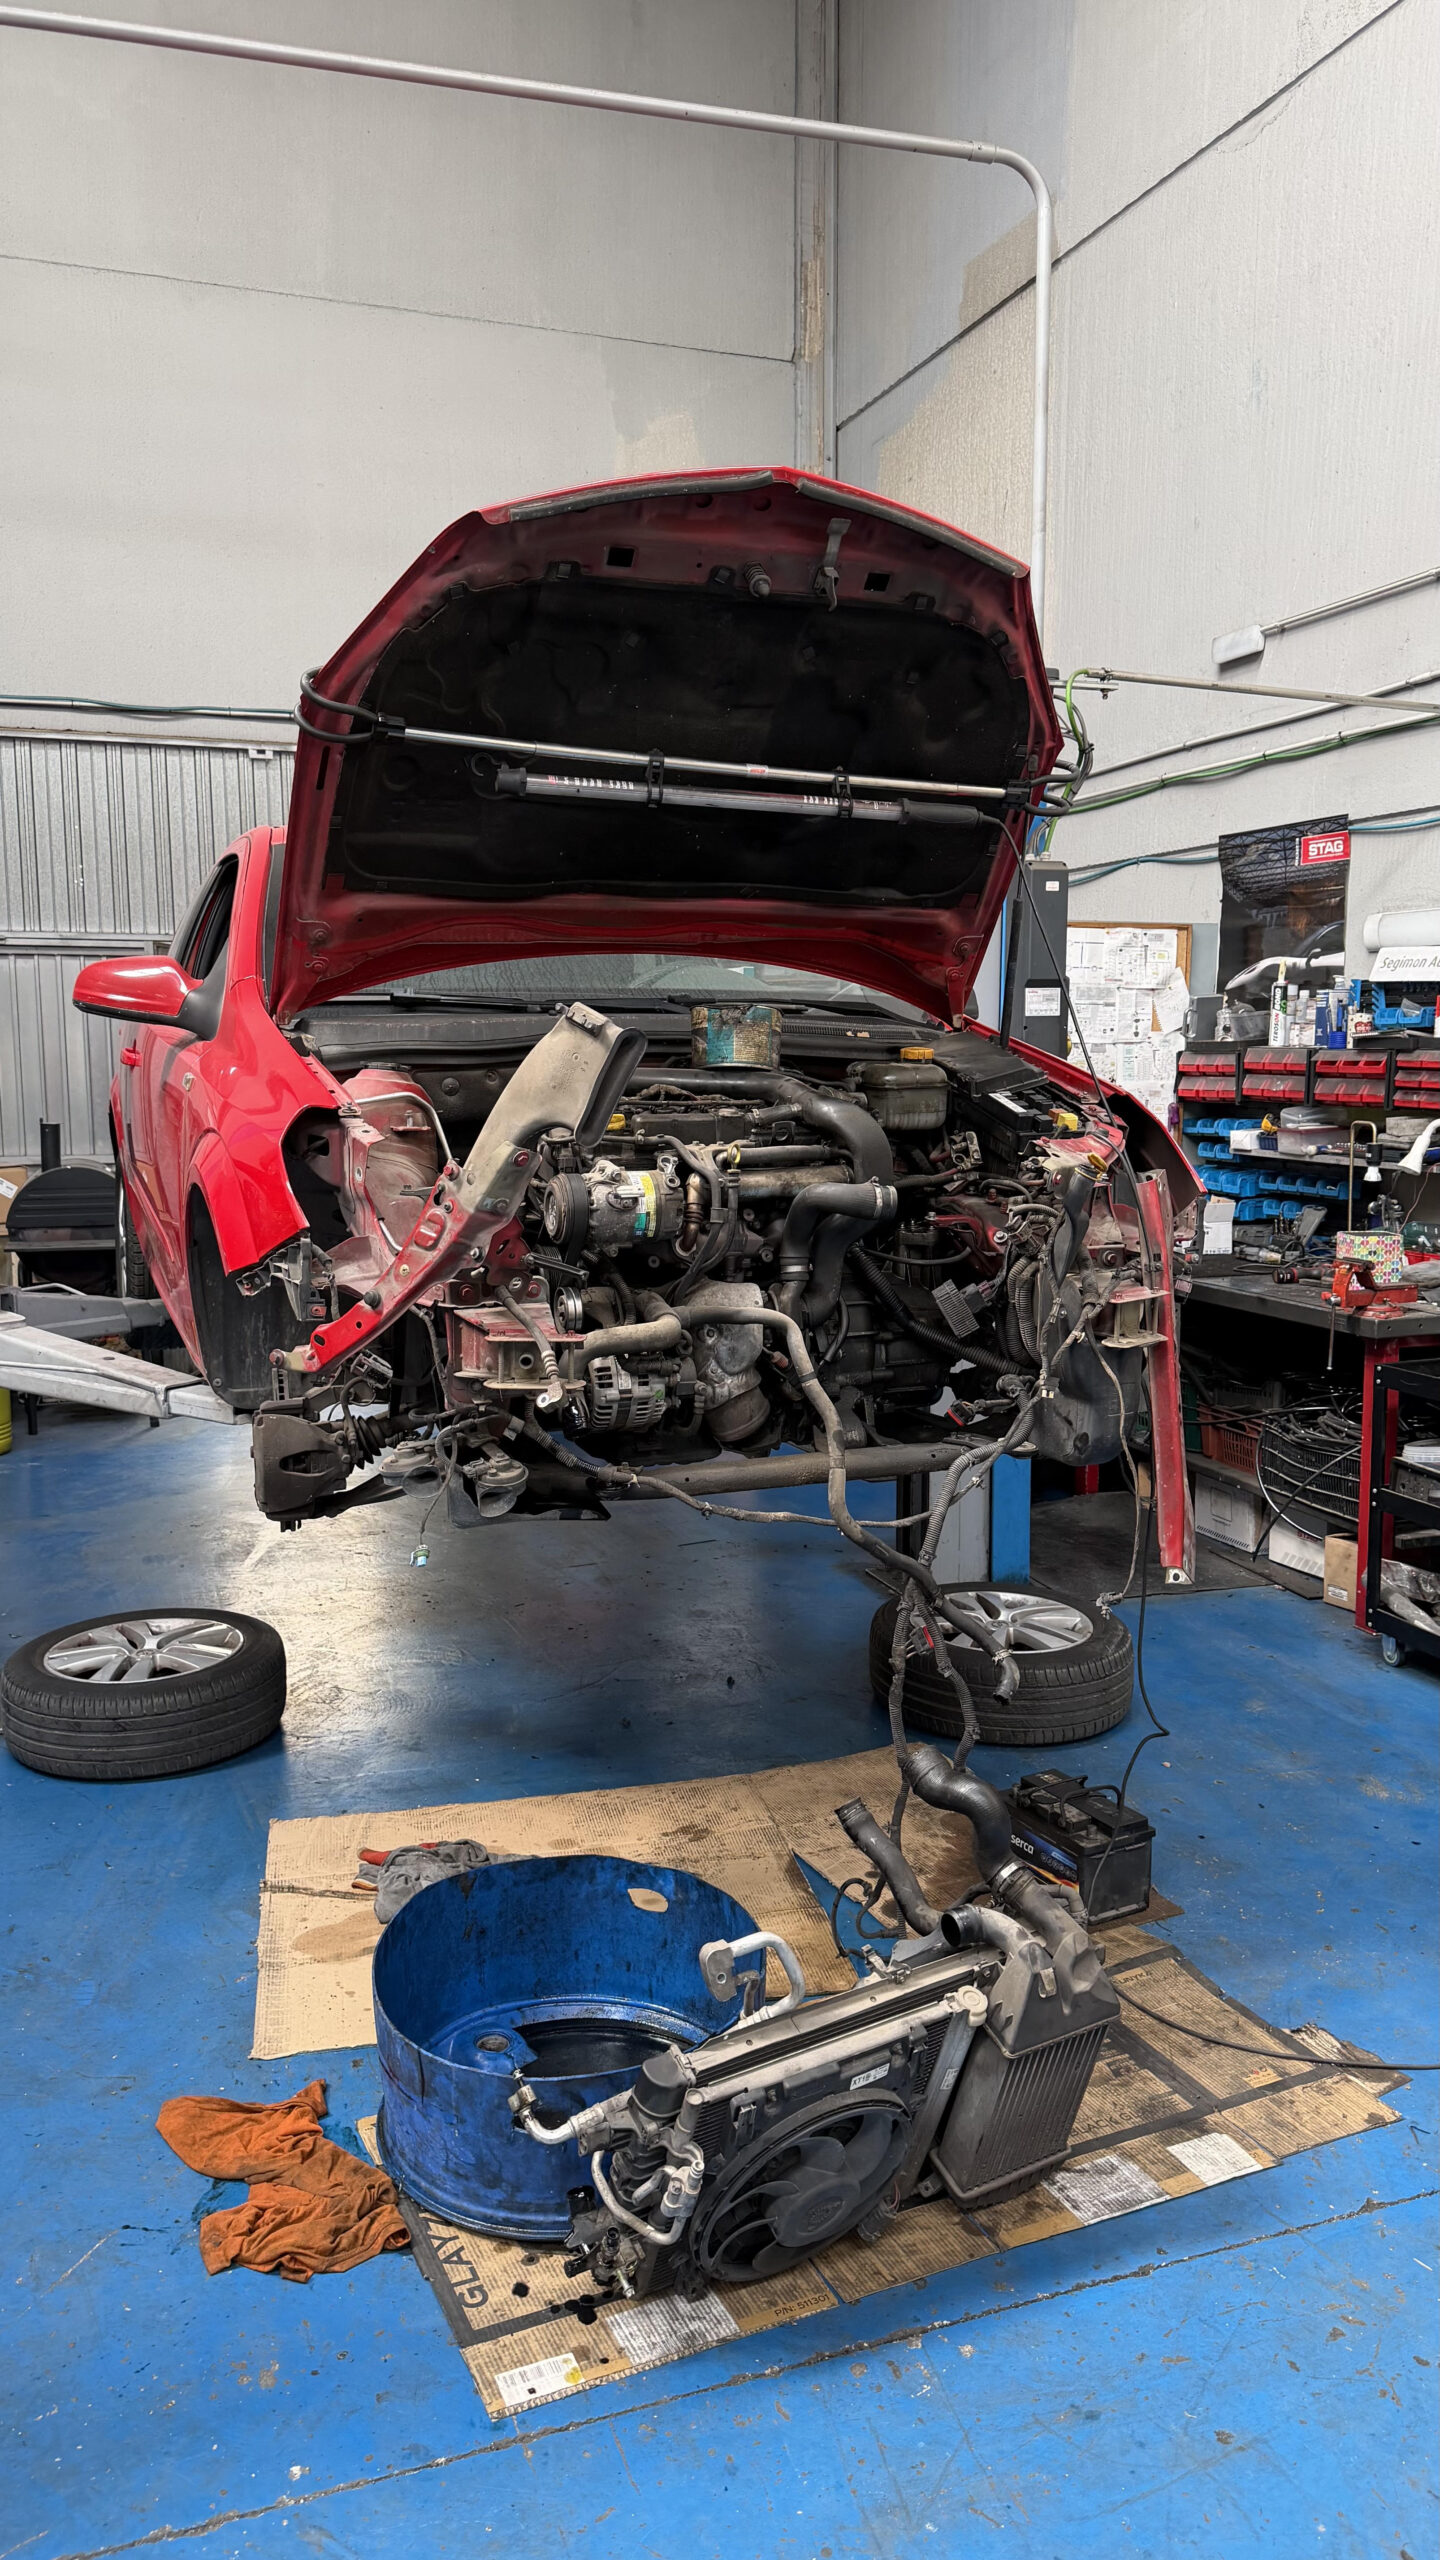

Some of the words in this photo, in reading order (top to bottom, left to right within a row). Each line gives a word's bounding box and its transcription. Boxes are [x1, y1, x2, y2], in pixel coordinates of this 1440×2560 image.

[1308, 840, 1344, 856] STAG
[1380, 956, 1427, 971] Segimon
[1274, 987, 1282, 1011] BOND
[1010, 1834, 1034, 1855] serca
[774, 2305, 797, 2317] P/N:
[796, 2294, 830, 2309] 511301
